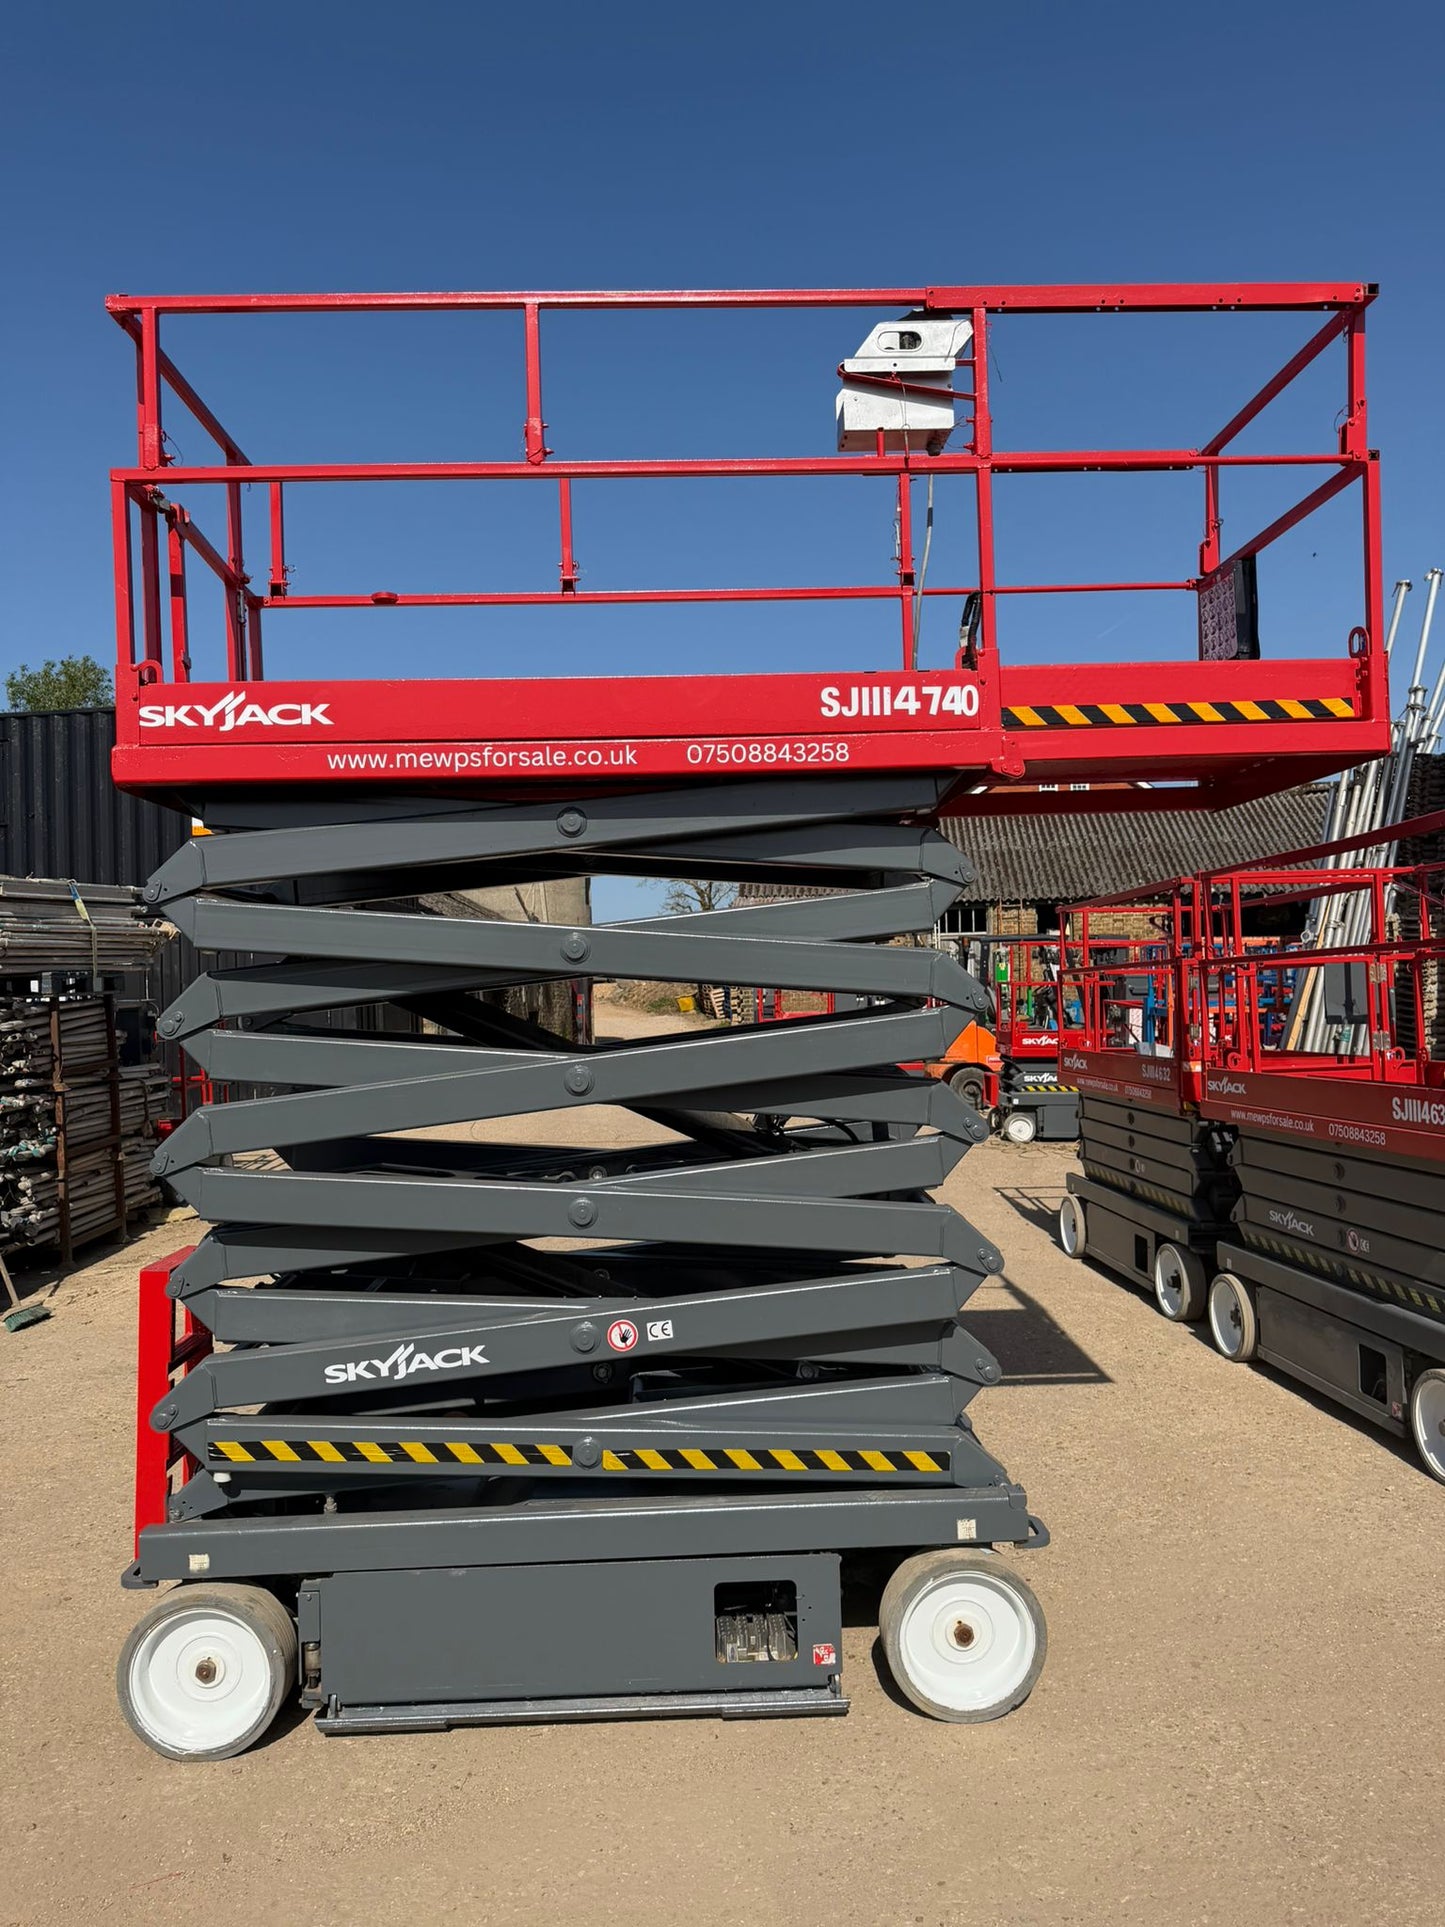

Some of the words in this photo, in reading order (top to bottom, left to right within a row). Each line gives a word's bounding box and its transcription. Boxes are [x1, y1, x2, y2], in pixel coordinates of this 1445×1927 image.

[139, 691, 334, 731] SKYJACK
[327, 744, 638, 772] www.mewpsforsale.co.uk
[686, 742, 850, 764] 07508843258
[1022, 1035, 1058, 1046] SKYJAC
[1207, 1076, 1247, 1094] SKYJACK
[1392, 1096, 1445, 1125] SJIII463
[1230, 1109, 1315, 1132] www.mewpsforsale.co.uk
[1328, 1123, 1386, 1145] 07508843258
[1268, 1209, 1315, 1237] SKYJACK
[324, 1343, 490, 1383] SKYJACK
